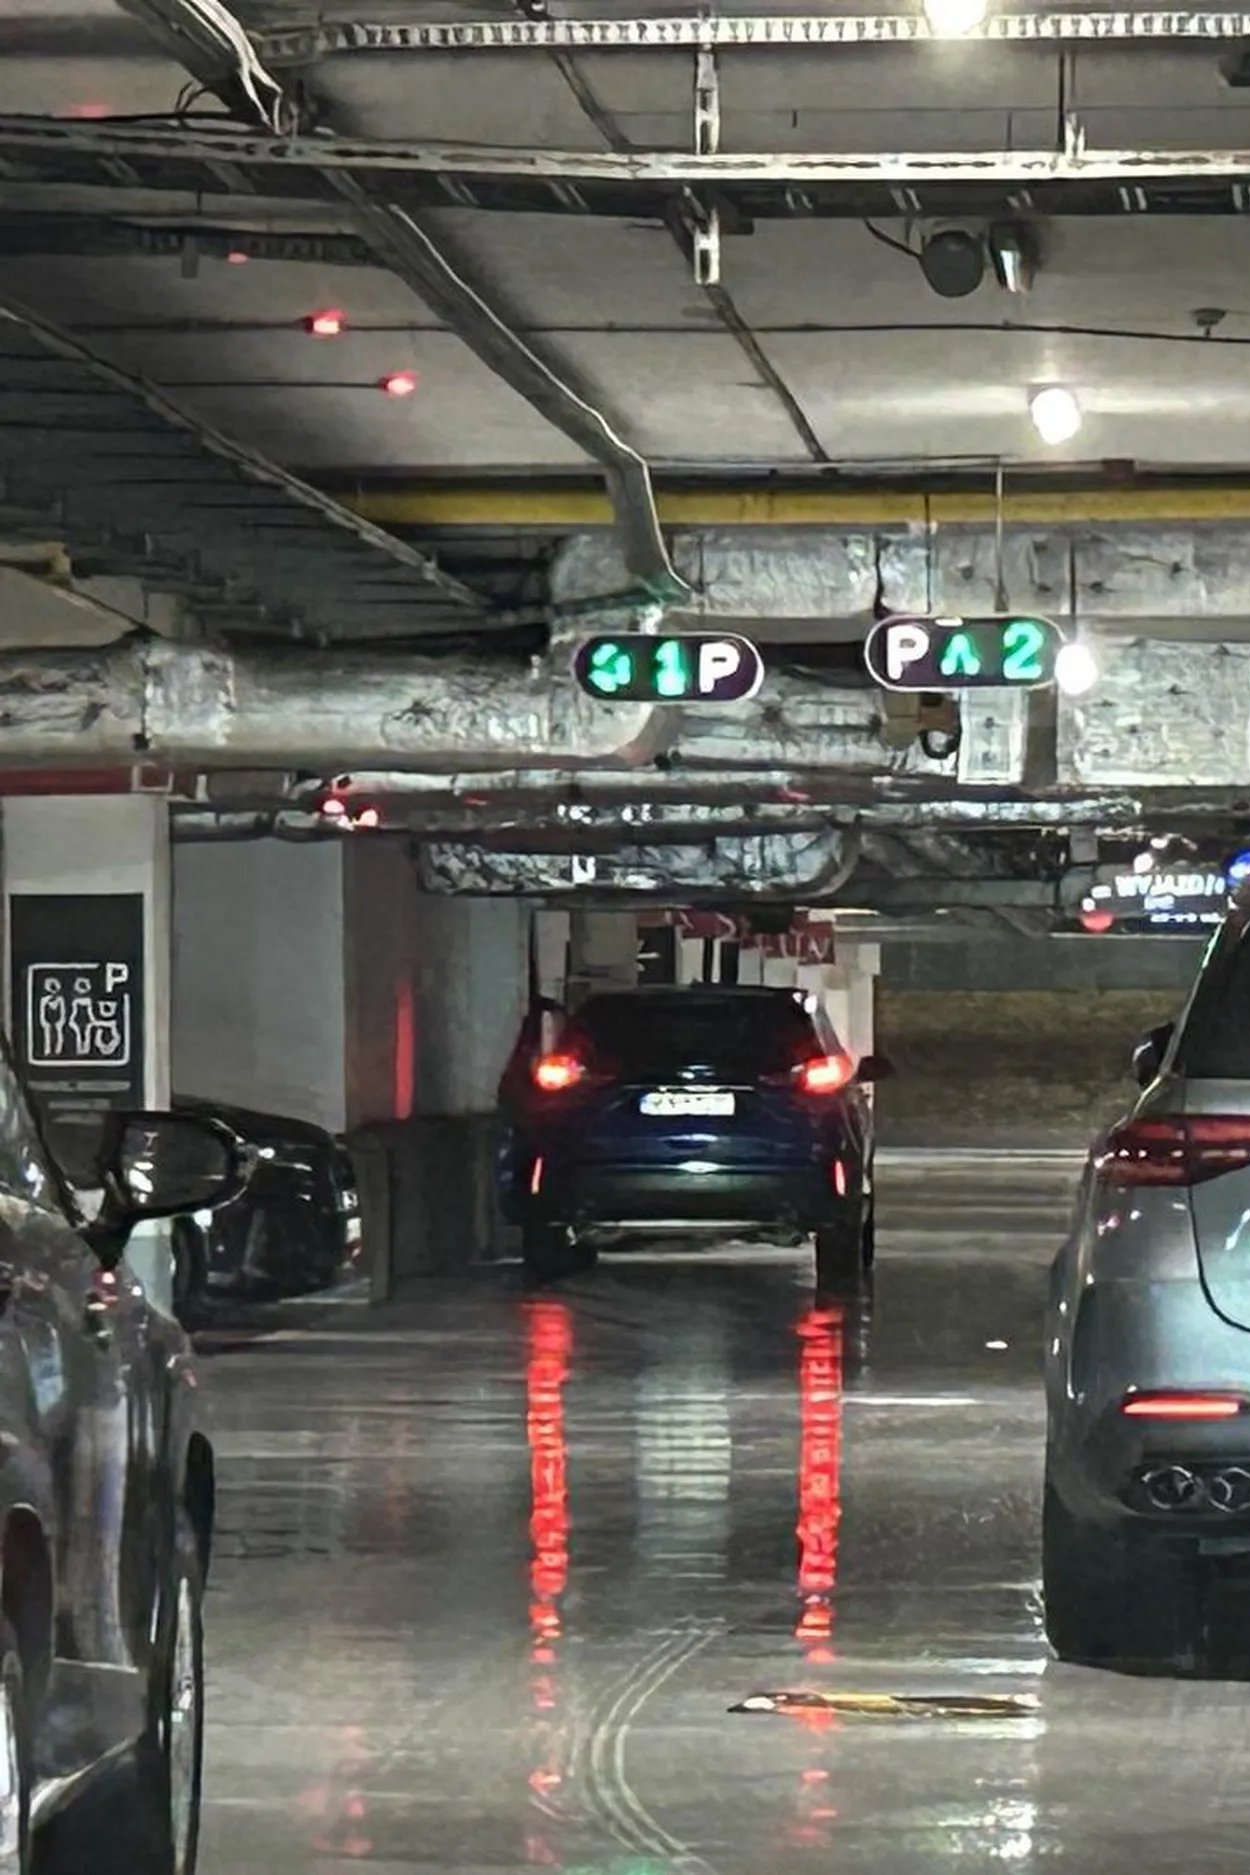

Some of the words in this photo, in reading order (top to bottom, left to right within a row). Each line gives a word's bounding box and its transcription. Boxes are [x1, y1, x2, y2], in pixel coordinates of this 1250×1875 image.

[653, 640, 686, 696] 1
[699, 641, 740, 694] P
[885, 623, 930, 680] P
[1002, 622, 1044, 680] 2
[105, 962, 129, 993] P
